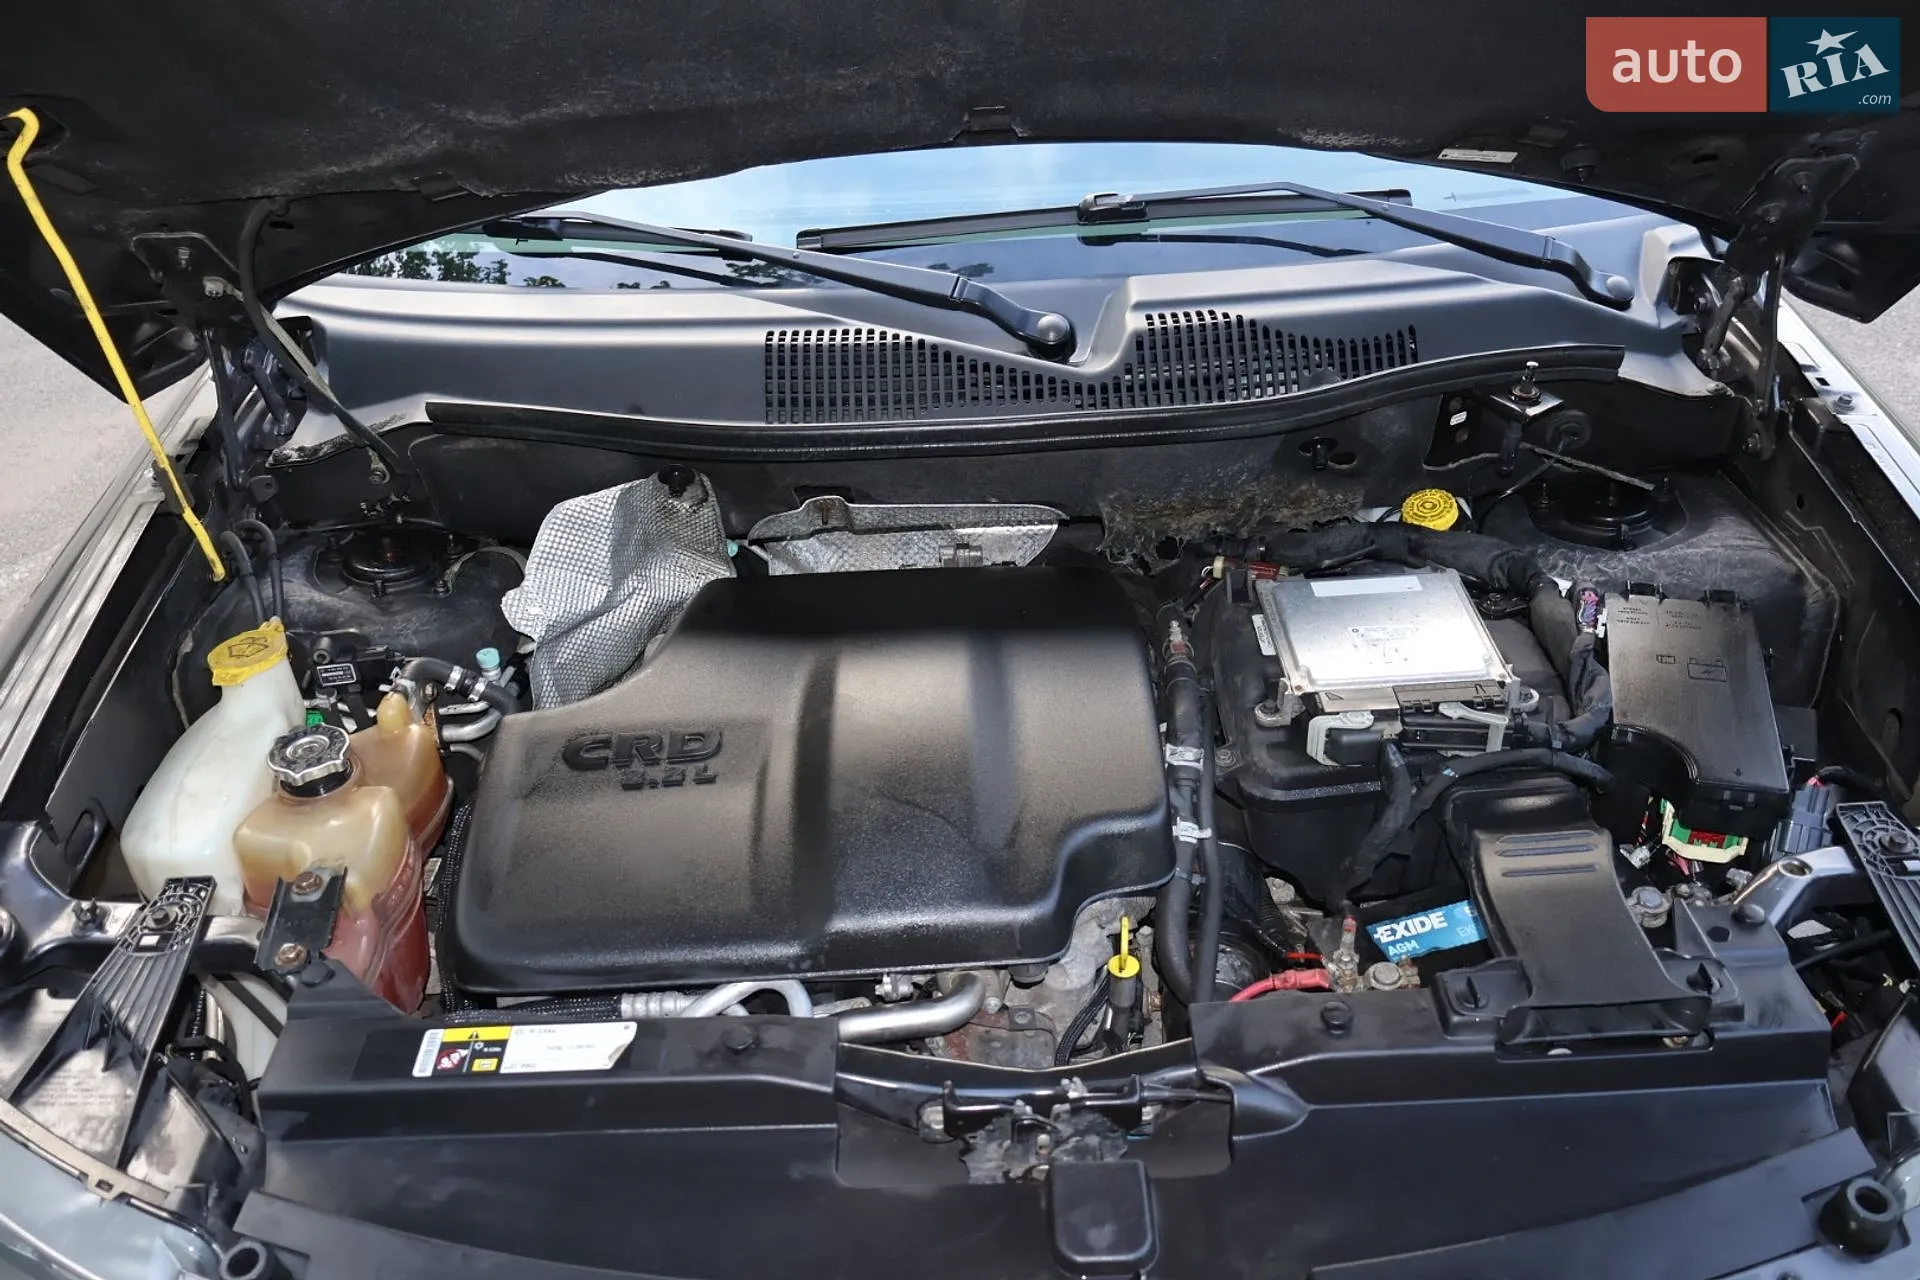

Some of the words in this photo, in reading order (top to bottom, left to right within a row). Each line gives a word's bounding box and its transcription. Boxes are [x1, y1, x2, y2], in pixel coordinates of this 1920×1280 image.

[562, 731, 723, 770] CRD
[1374, 911, 1448, 943] EXIDE
[1387, 940, 1420, 956] AGM
